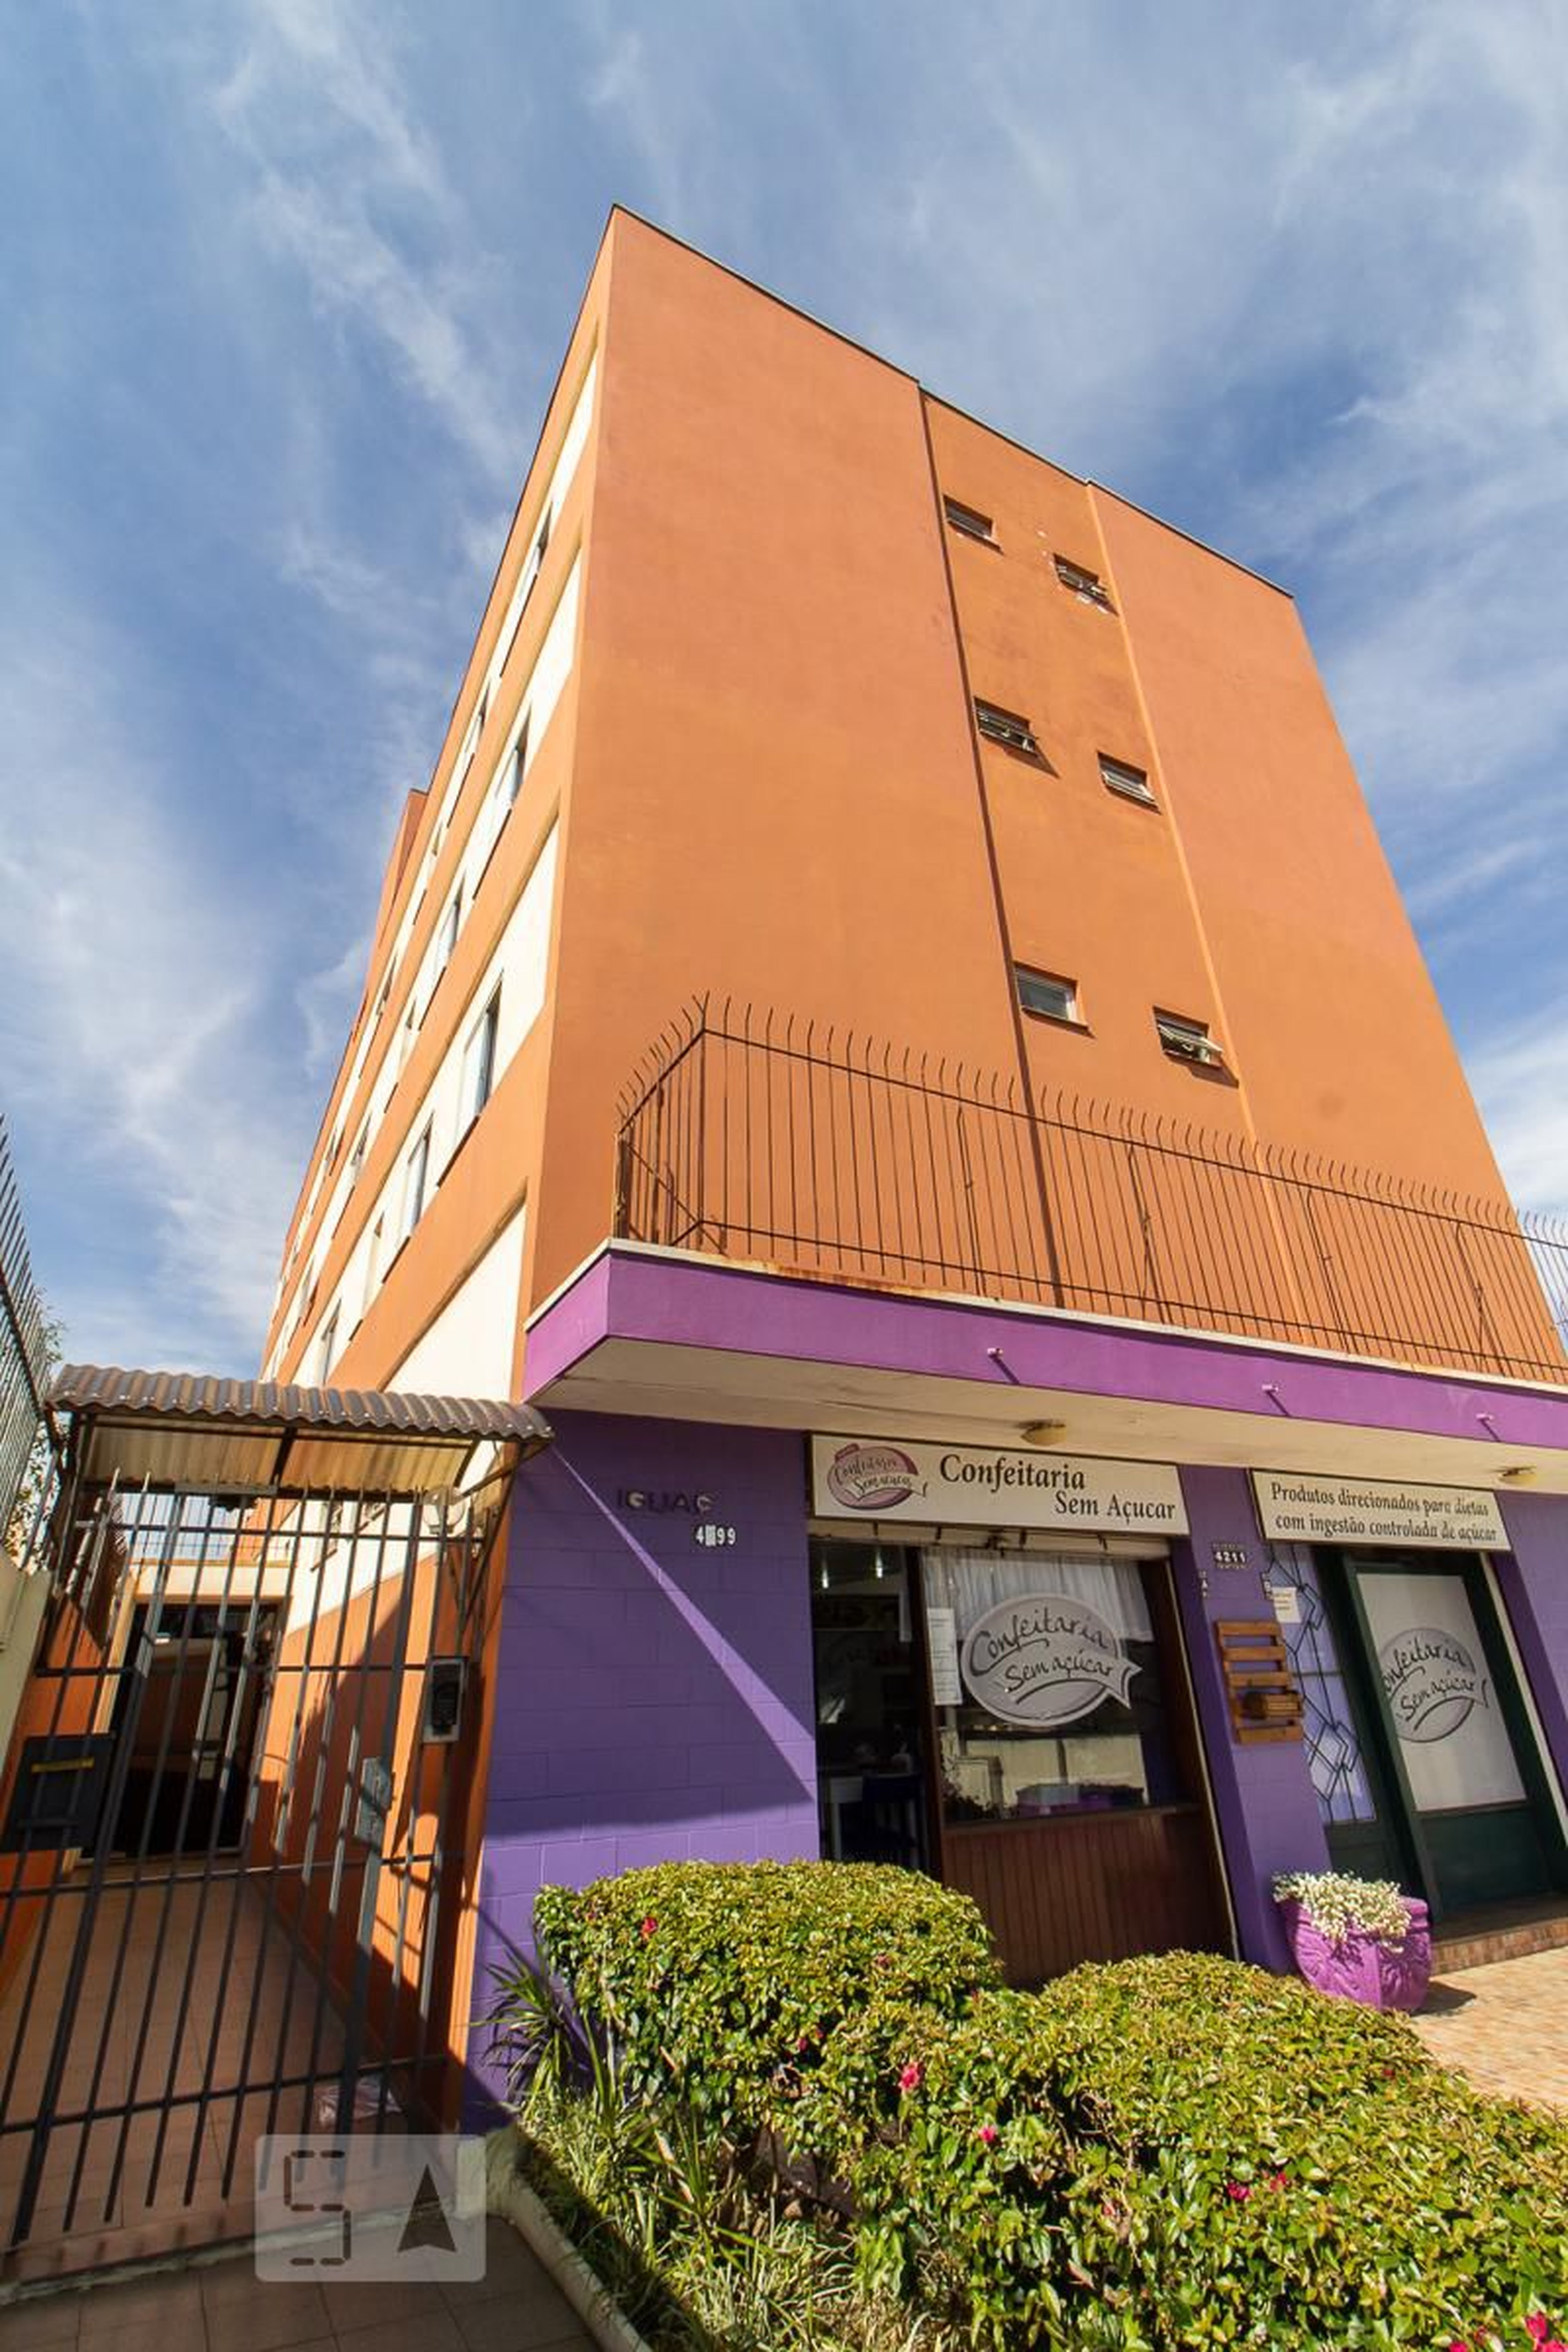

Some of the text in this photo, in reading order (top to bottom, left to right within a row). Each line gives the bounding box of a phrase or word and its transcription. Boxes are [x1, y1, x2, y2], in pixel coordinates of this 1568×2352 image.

[940, 1454, 1085, 1493] Confeitaria
[1055, 1490, 1176, 1526] Sem Açucar
[1271, 1481, 1489, 1517] Produtos direcionados para dietas
[1276, 1515, 1305, 1530] com
[1309, 1512, 1365, 1538] ingestão
[1370, 1519, 1438, 1537] controlada
[1441, 1521, 1457, 1539] de
[1214, 1550, 1246, 1563] 4211
[970, 1607, 1107, 1677] Confeitaria
[1005, 1661, 1049, 1694] Sem
[1400, 1691, 1430, 1722] Sem
